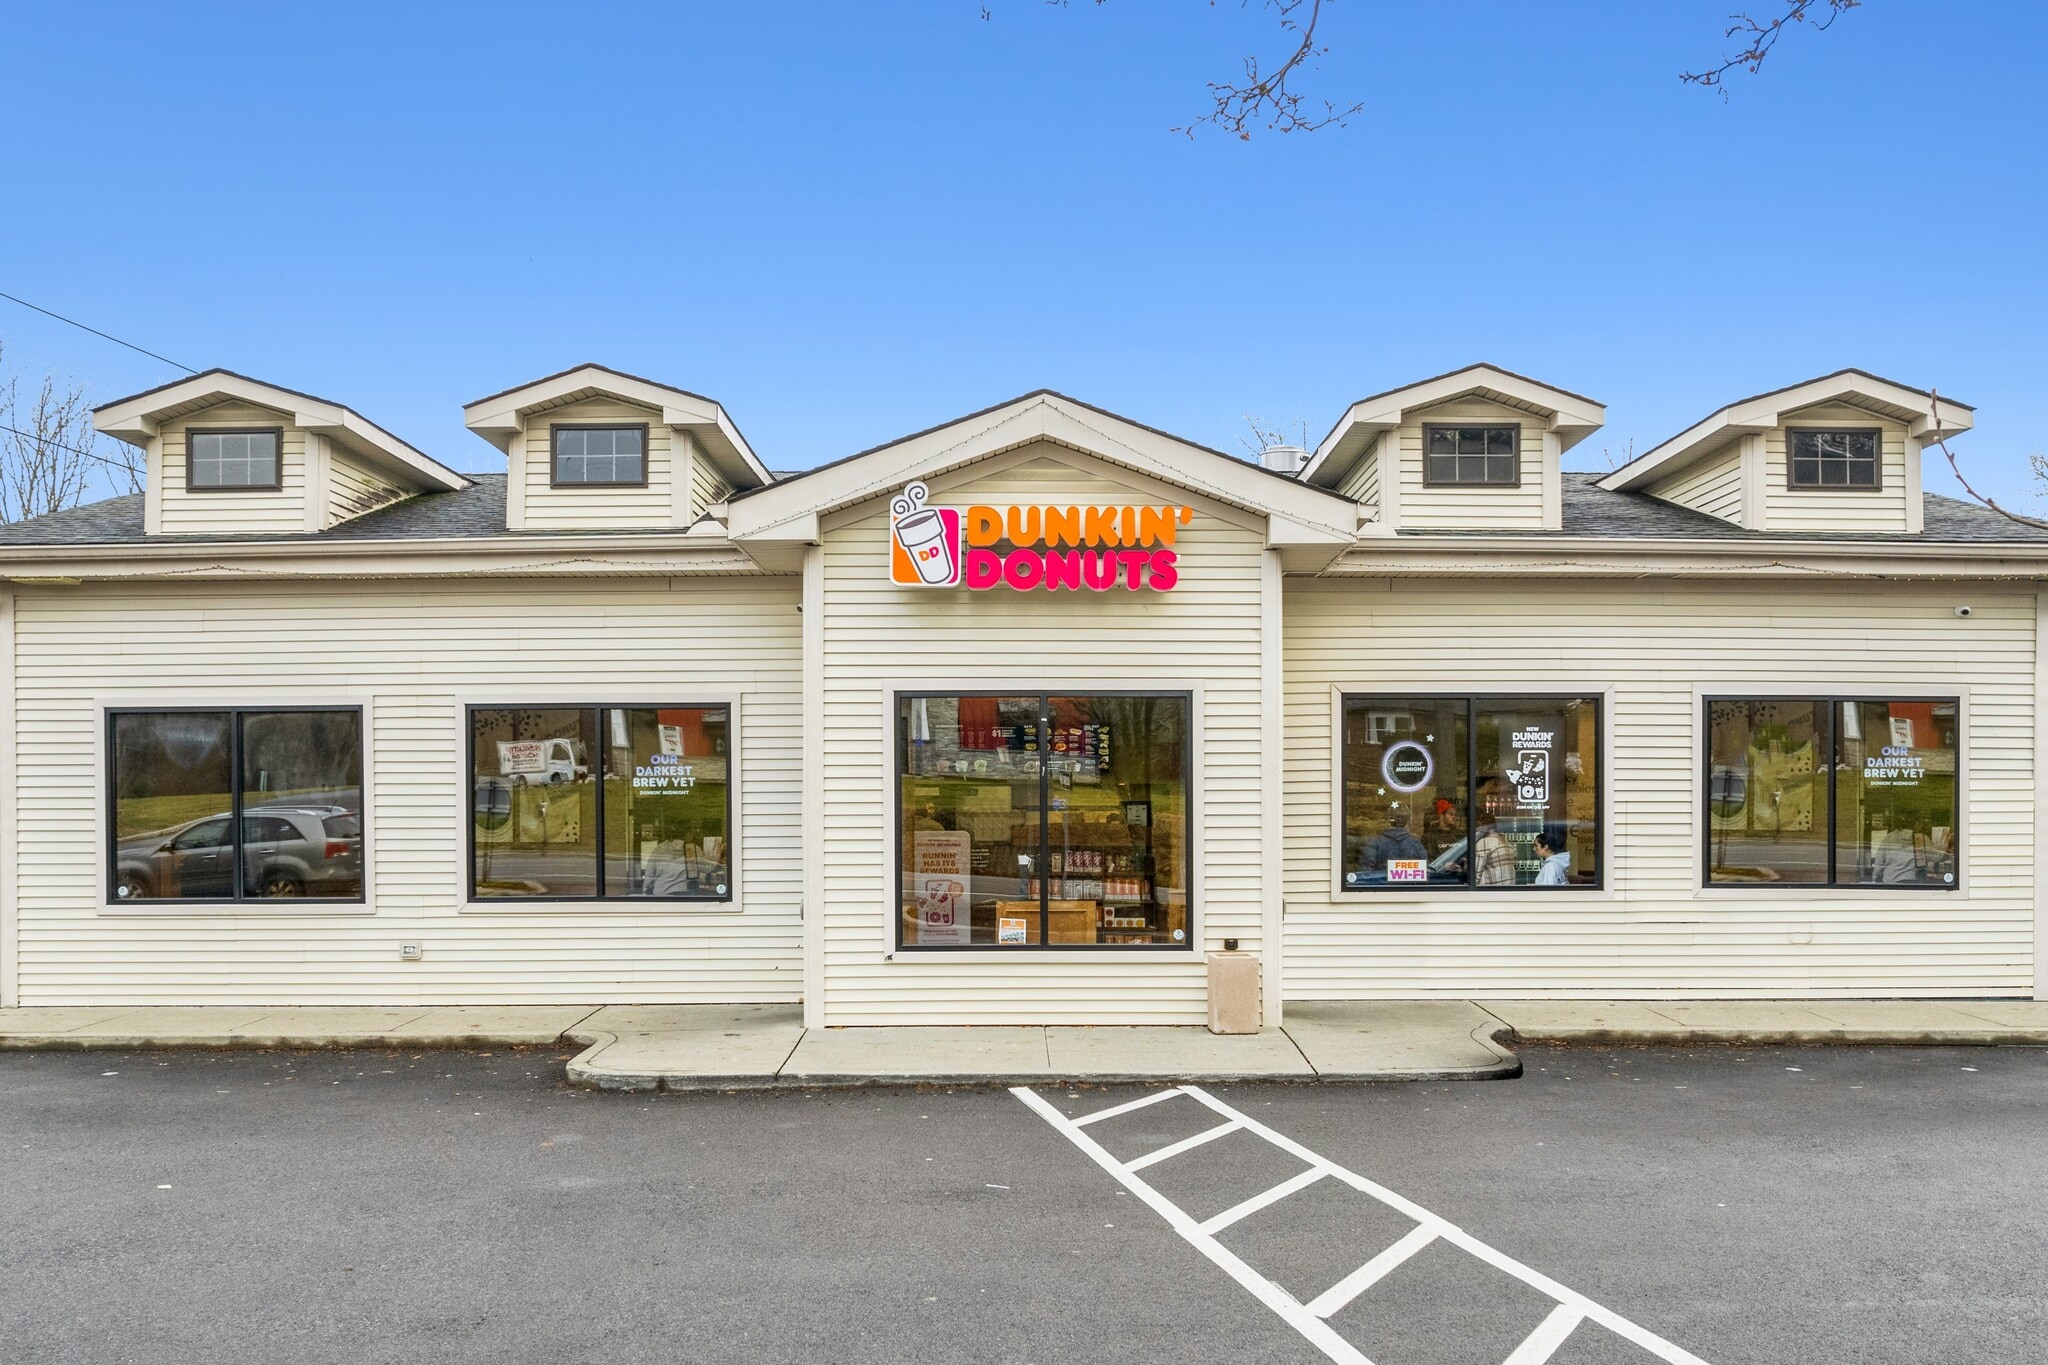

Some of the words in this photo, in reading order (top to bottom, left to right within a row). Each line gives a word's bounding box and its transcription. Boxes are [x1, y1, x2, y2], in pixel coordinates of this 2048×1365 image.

[967, 505, 1193, 547] DUNKIN'
[918, 546, 940, 562] DD
[965, 548, 1179, 592] DONUTS
[1512, 732, 1554, 741] DUNKIN'
[1881, 746, 1908, 756] OUR
[650, 754, 678, 765] OUR
[1867, 757, 1922, 767] DARKEST
[636, 766, 693, 776] DARKEST
[1864, 768, 1899, 778] BREW
[1901, 768, 1925, 778] YET
[633, 777, 669, 787] BREW
[671, 777, 696, 787] YET
[922, 852, 958, 860] RUNNIN'
[1395, 861, 1420, 869] FREE
[920, 867, 960, 875] REWARDS
[1390, 869, 1425, 880] WI-FI
